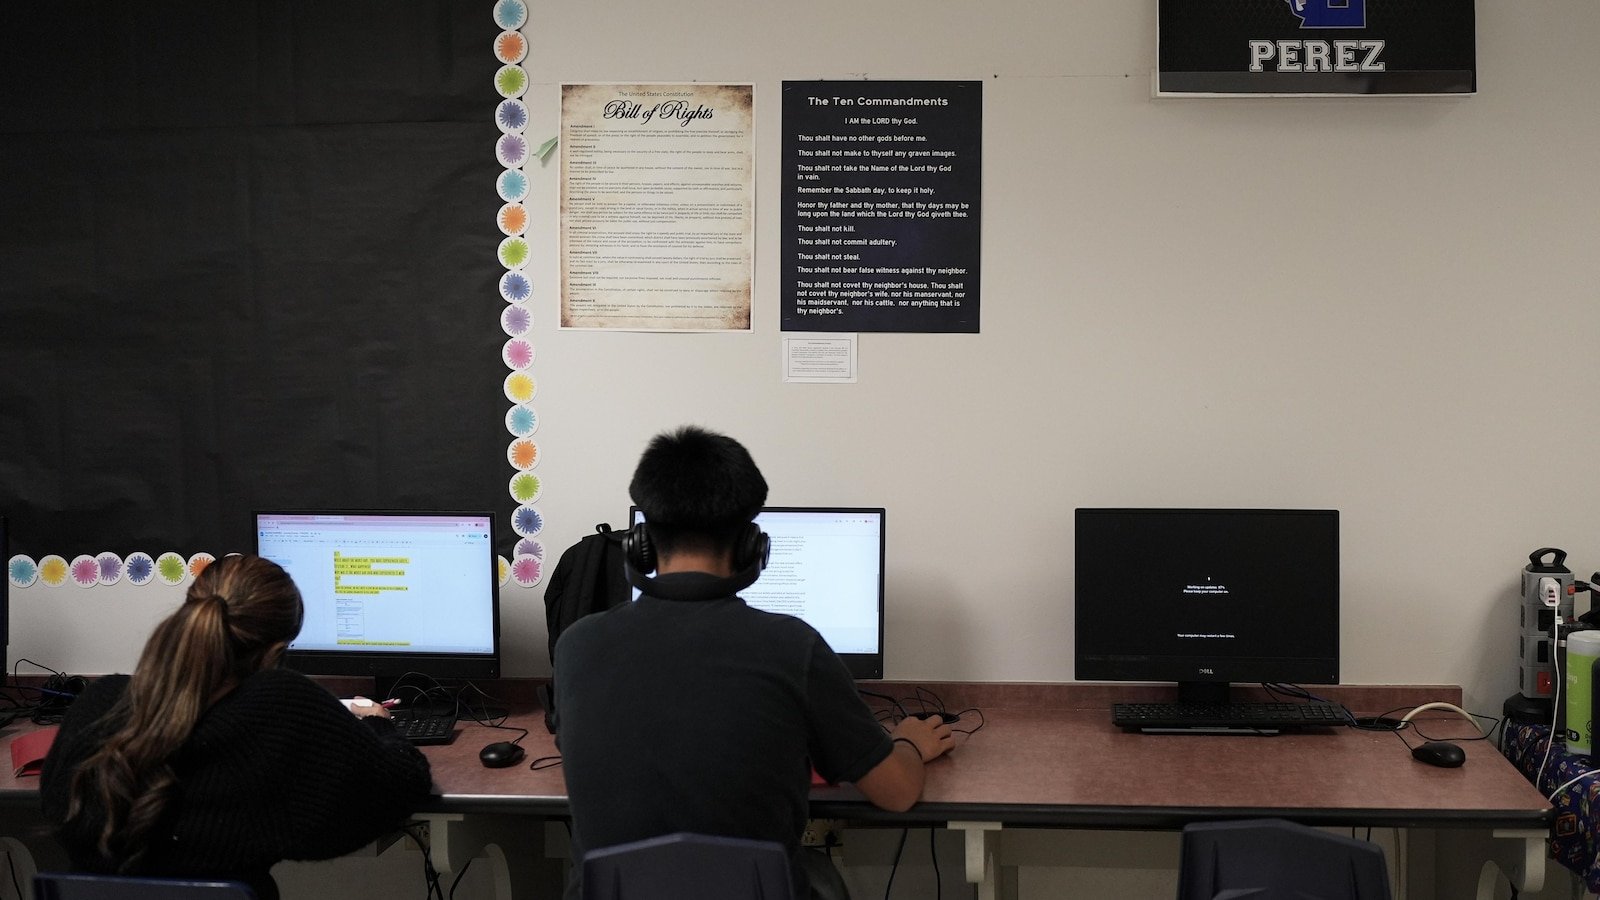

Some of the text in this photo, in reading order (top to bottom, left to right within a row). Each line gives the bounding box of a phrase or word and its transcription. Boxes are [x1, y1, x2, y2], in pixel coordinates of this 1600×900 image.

[1248, 40, 1386, 72] PEREZ
[808, 97, 948, 105] The Ten Commandments
[604, 100, 713, 127] Bill of Rights
[876, 135, 892, 143] gods
[871, 150, 892, 158] thyself
[932, 150, 956, 158] images.
[926, 165, 937, 173] thy
[896, 187, 912, 195] keep
[920, 187, 934, 195] holy.
[818, 202, 828, 210] thy
[863, 202, 874, 210] thy
[916, 202, 926, 210] thy
[928, 202, 943, 210] days
[797, 210, 810, 218] long
[904, 211, 915, 219] thy
[930, 211, 951, 219] giveth
[869, 239, 896, 247] adultery.
[901, 267, 924, 275] against
[926, 267, 936, 275] thy
[938, 267, 967, 275] neighbor.
[862, 282, 872, 290] thy
[874, 282, 907, 290] neighbor's
[828, 290, 838, 298] thy
[840, 290, 872, 298] neighbor's
[911, 300, 938, 308] anything
[797, 308, 843, 316] thy neighbor's.
